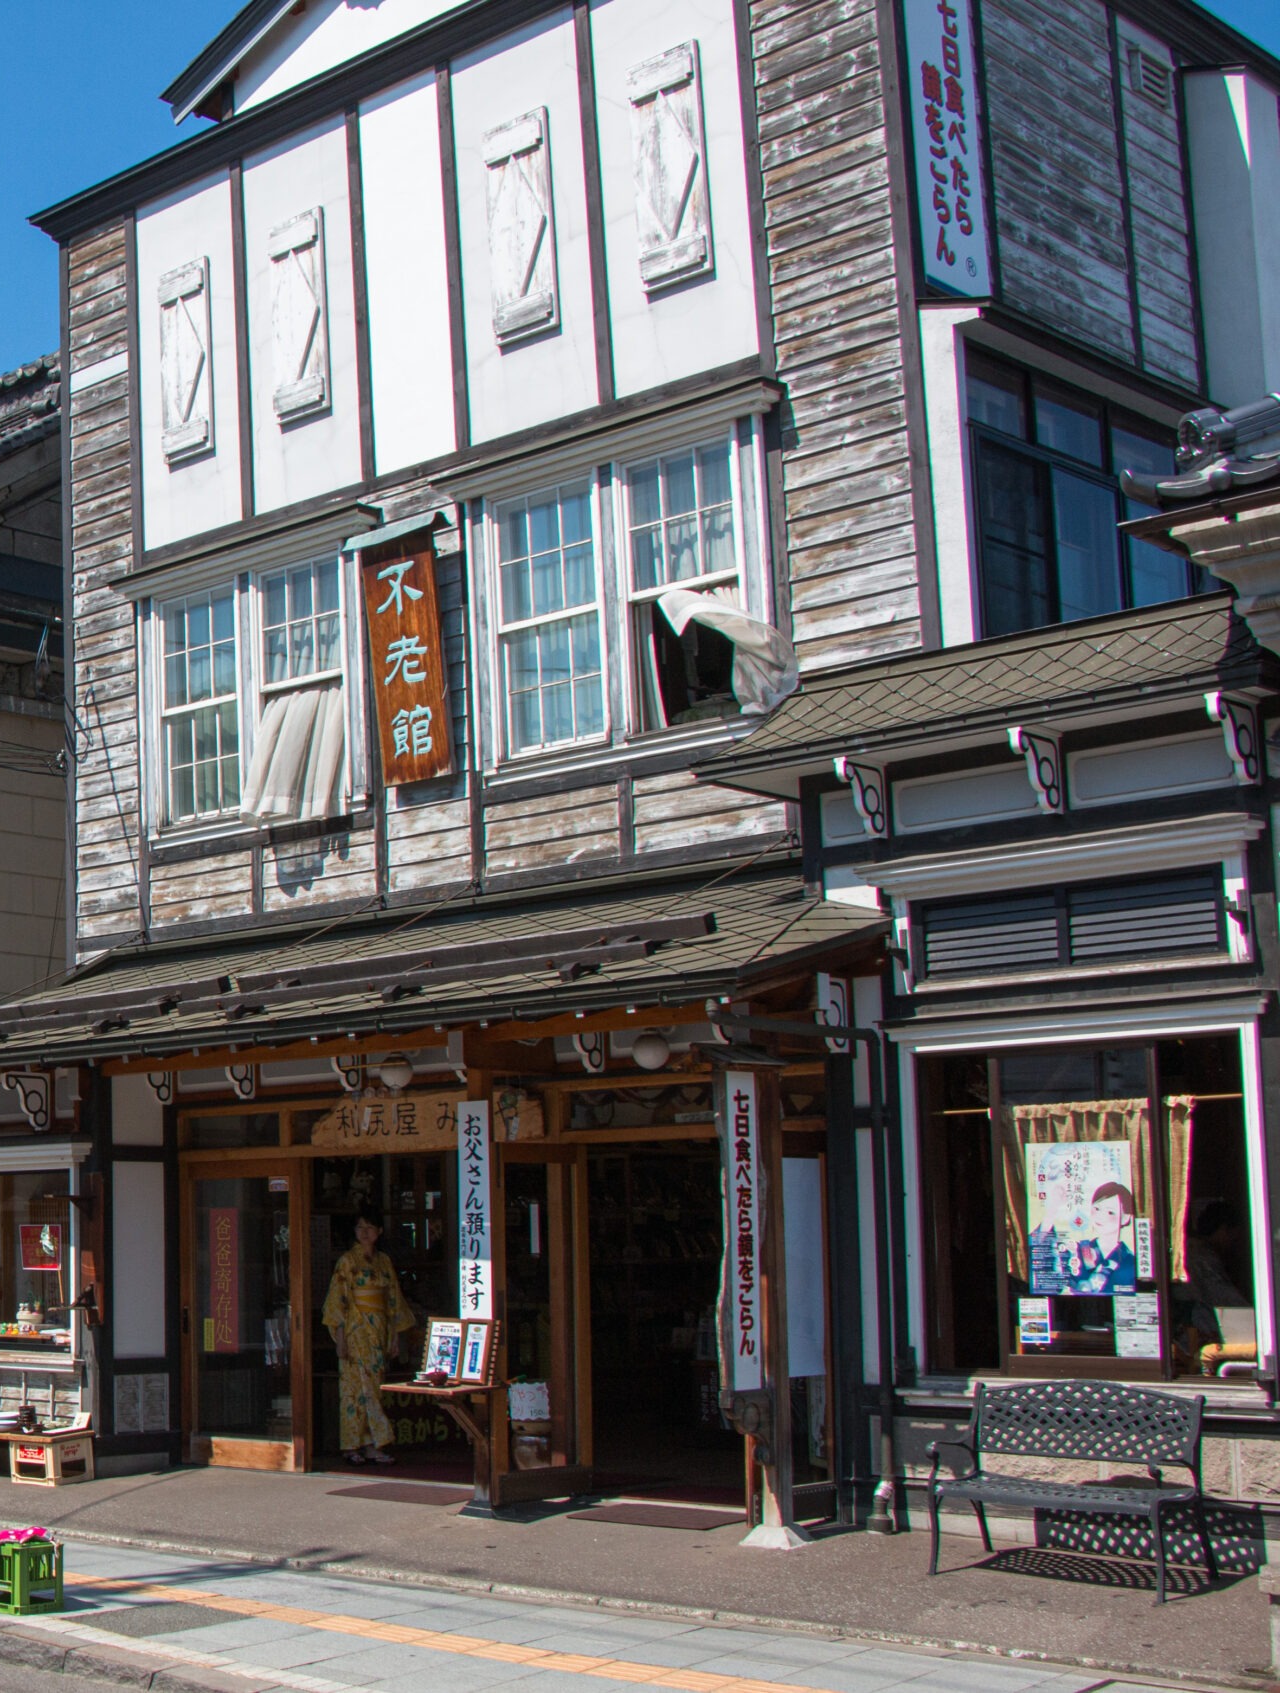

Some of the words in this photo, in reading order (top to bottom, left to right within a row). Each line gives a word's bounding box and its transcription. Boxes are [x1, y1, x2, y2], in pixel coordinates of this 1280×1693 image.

[376, 559, 433, 760] 不老館
[215, 1215, 233, 1345] 爸爸寄存处
[463, 1113, 486, 1311] お父さん預ります
[733, 1088, 756, 1357] 七日食べたら鏡をごらん
